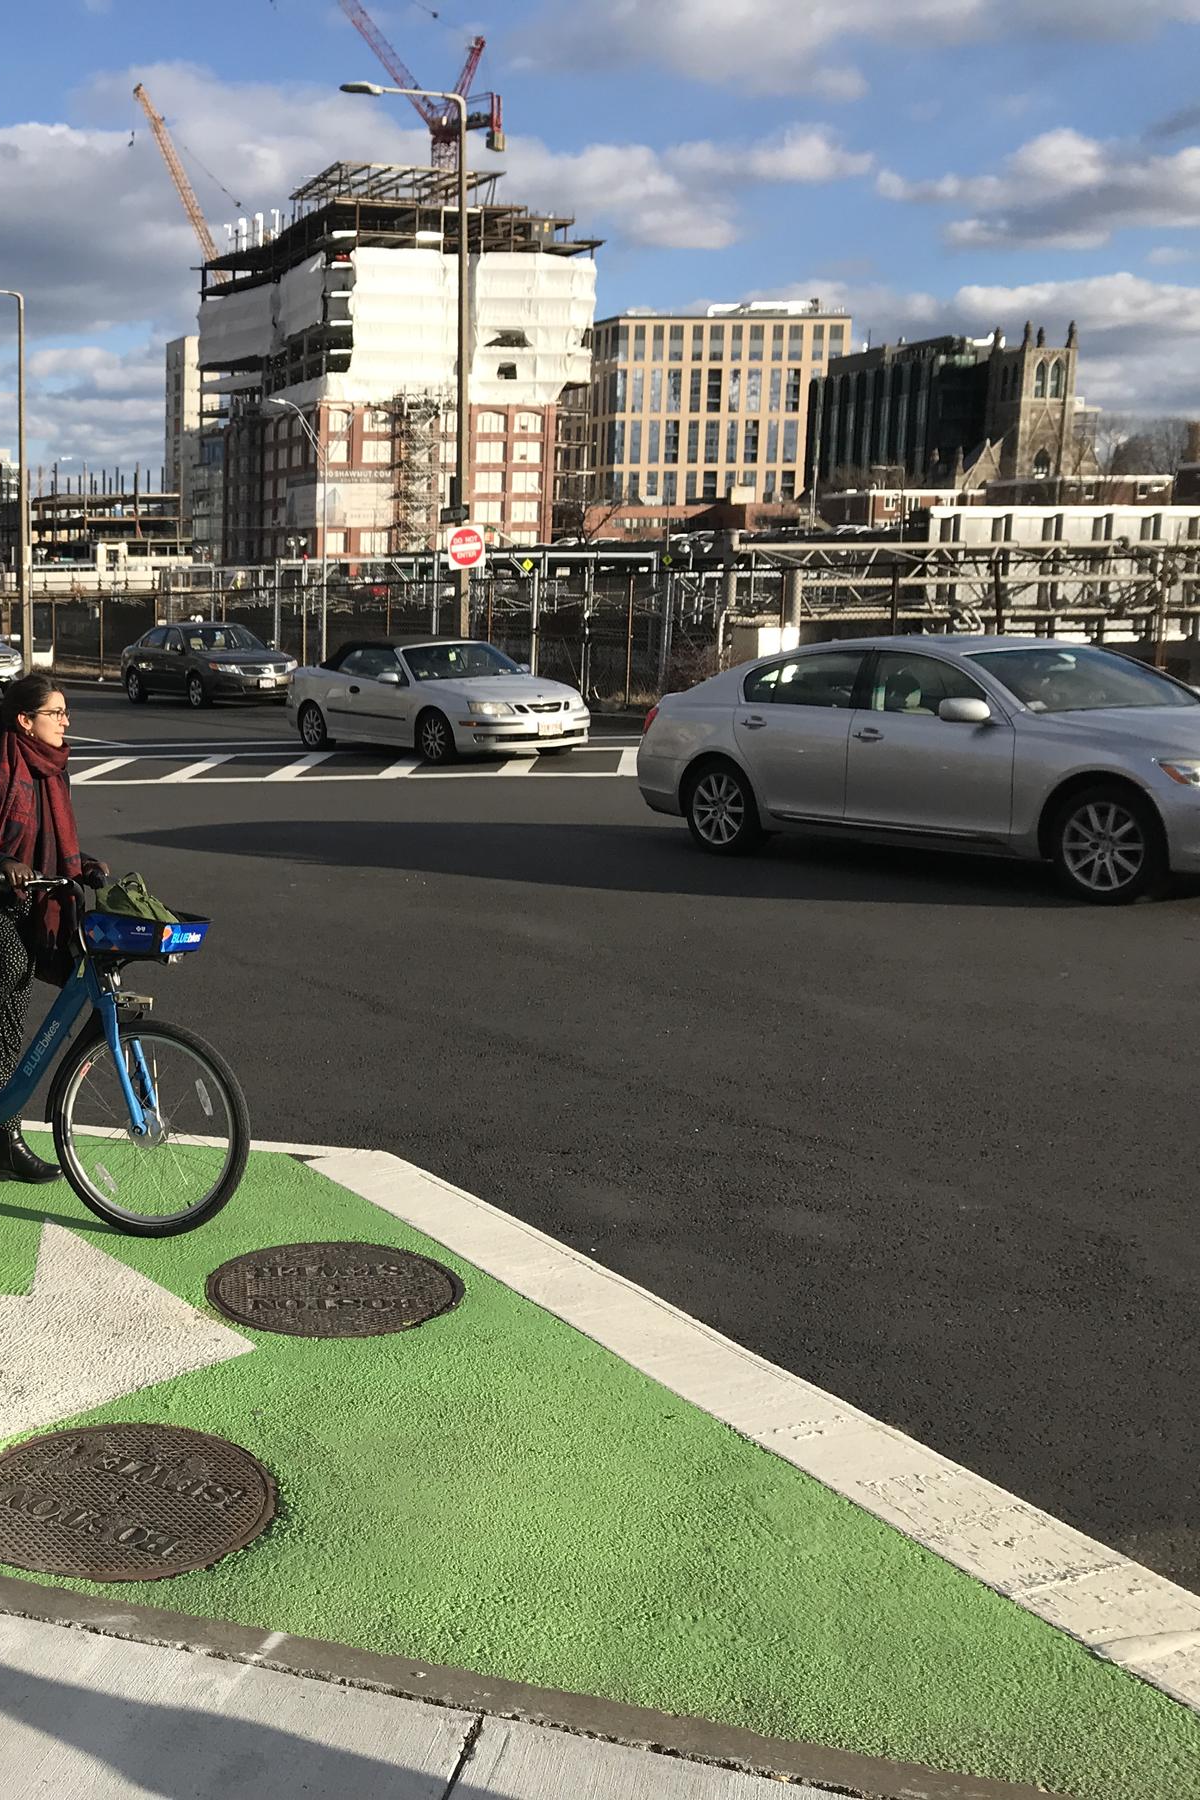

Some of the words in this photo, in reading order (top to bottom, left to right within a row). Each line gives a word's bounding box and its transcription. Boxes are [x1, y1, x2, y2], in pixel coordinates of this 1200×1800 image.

[464, 535, 478, 543] NOT
[457, 551, 477, 559] ENTER
[171, 932, 202, 944] BLUEbikes
[23, 1020, 60, 1077] BLUEbikes
[250, 1297, 419, 1312] BOSTON
